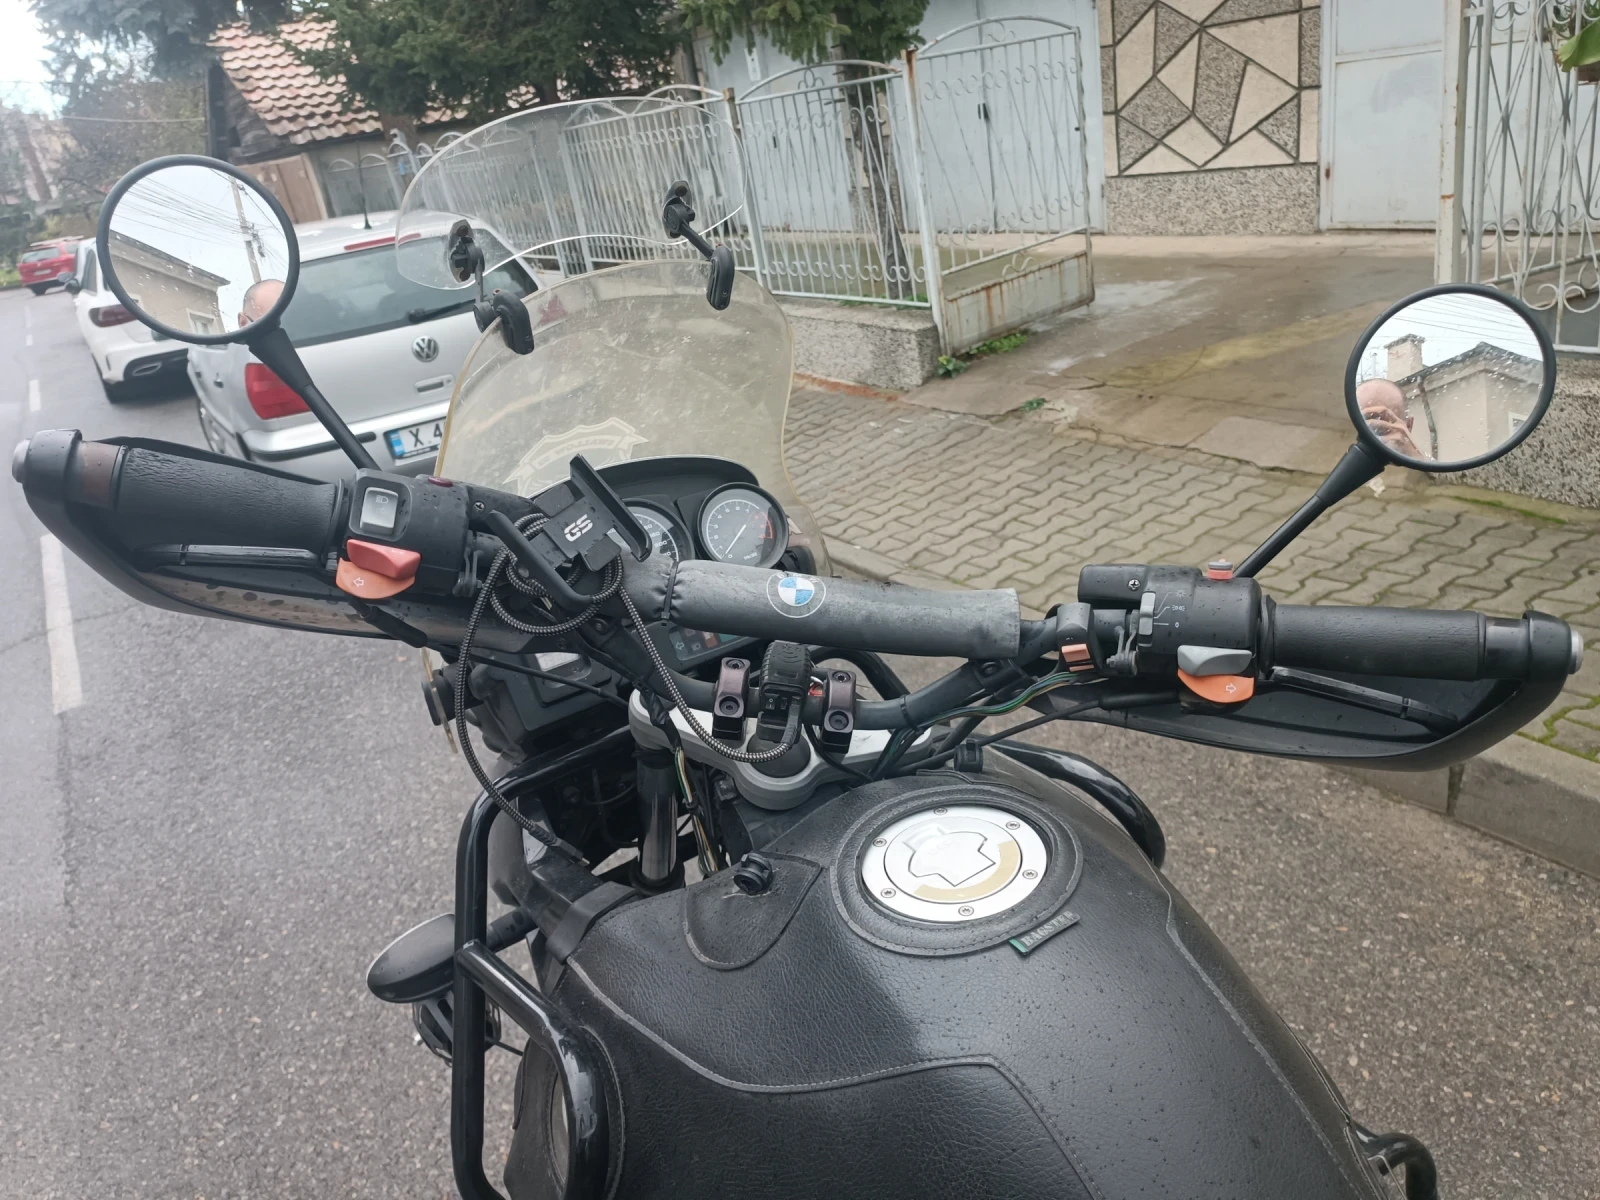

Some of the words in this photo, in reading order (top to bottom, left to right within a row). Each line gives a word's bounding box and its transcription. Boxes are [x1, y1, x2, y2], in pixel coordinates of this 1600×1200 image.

[409, 428, 424, 447] X
[564, 513, 593, 542] GS
[1021, 911, 1075, 947] BAGSTER
